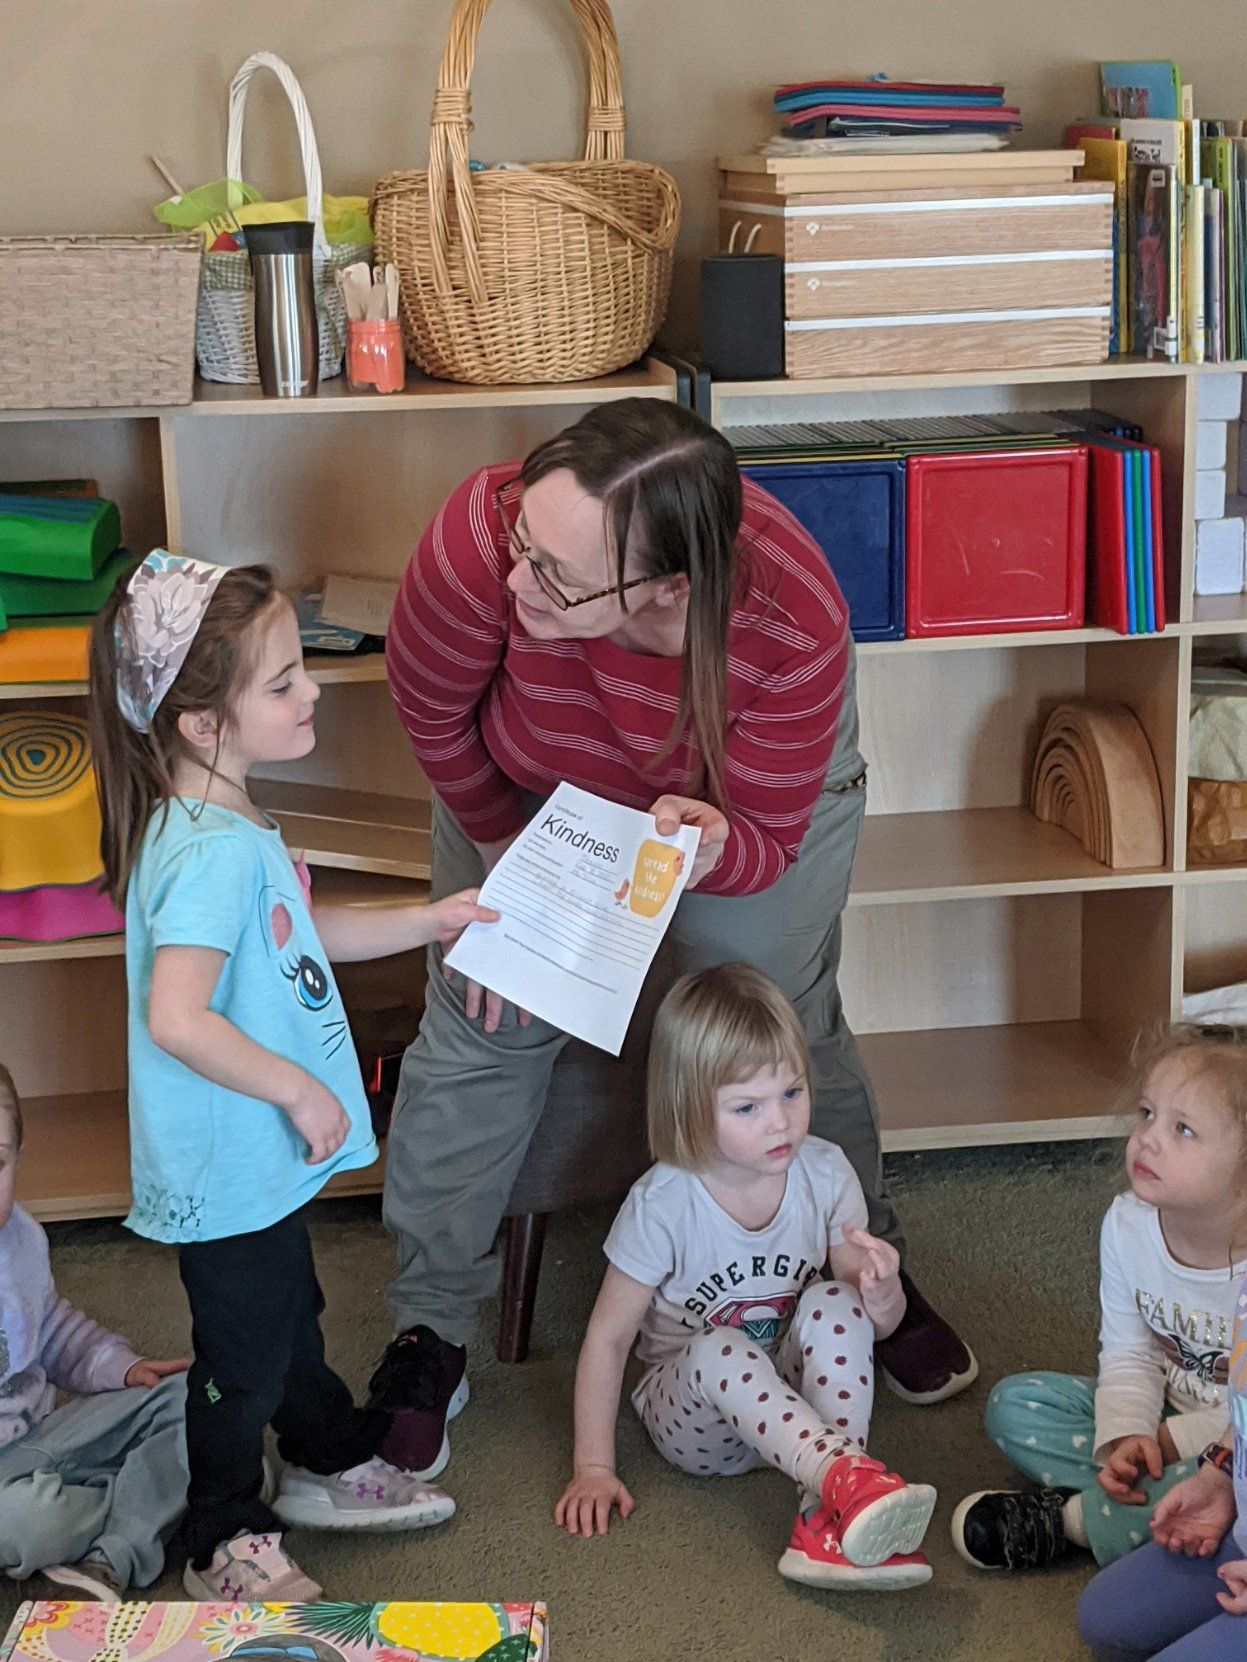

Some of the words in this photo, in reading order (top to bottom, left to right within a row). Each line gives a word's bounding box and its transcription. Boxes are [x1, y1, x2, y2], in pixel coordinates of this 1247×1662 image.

[540, 813, 620, 863] Kindness
[684, 1253, 818, 1316] SUPERGIR
[1135, 1287, 1232, 1351] FAMIL
